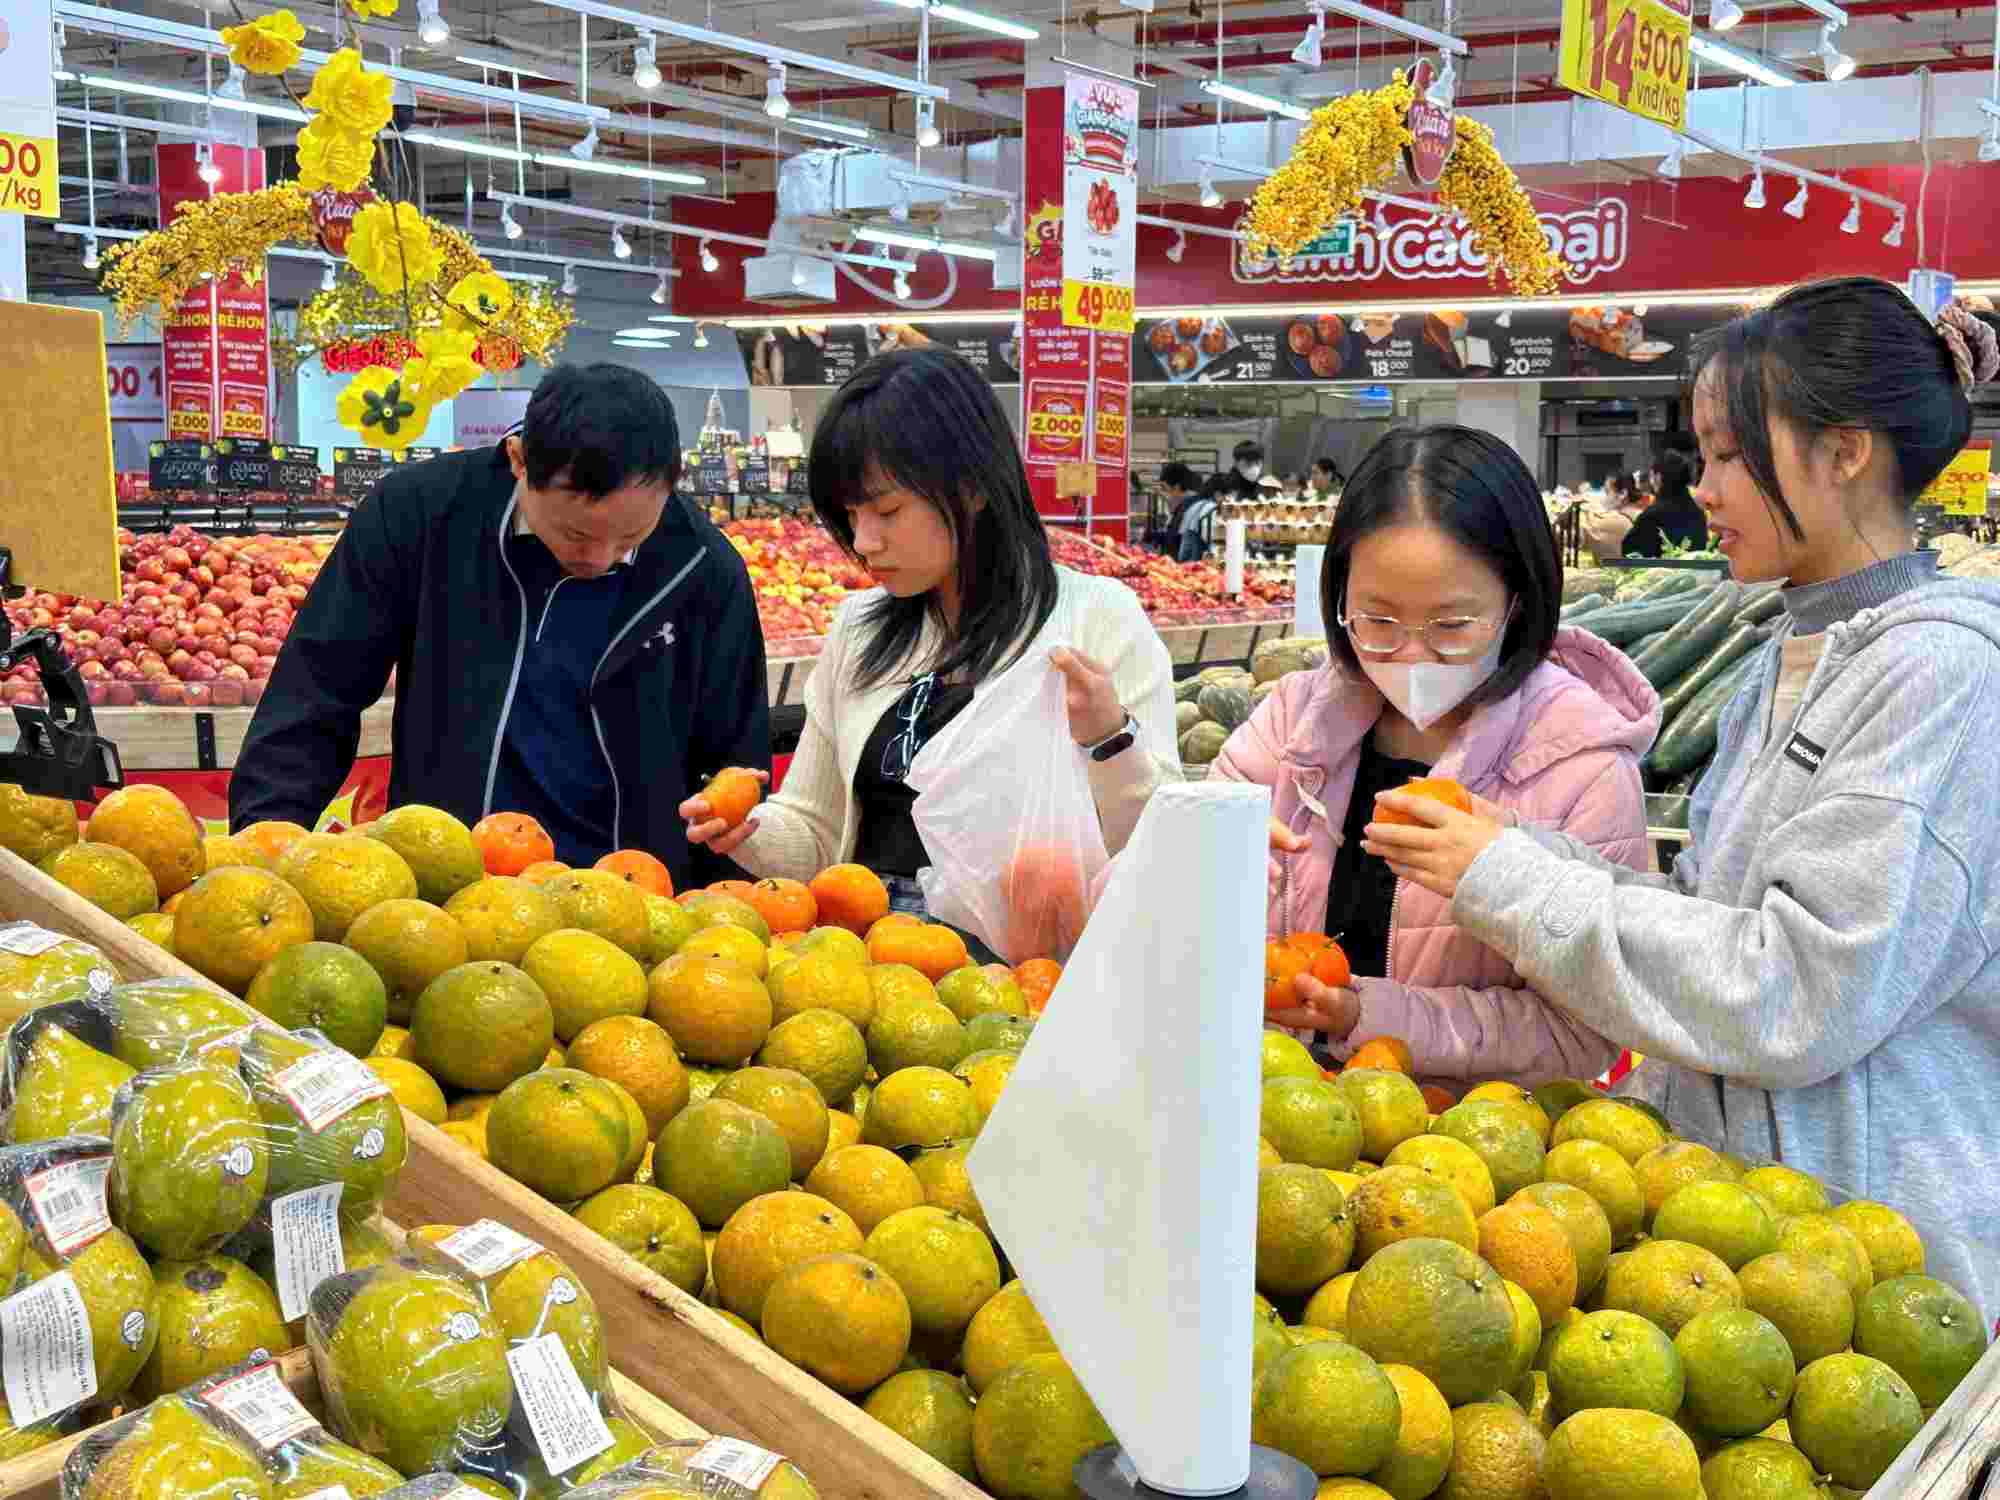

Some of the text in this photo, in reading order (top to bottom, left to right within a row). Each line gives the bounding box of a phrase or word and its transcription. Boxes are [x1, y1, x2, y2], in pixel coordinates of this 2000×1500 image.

[1636, 82, 1680, 127] vnd/kg
[224, 415, 262, 430] 2.000
[1031, 417, 1082, 434] 2.000
